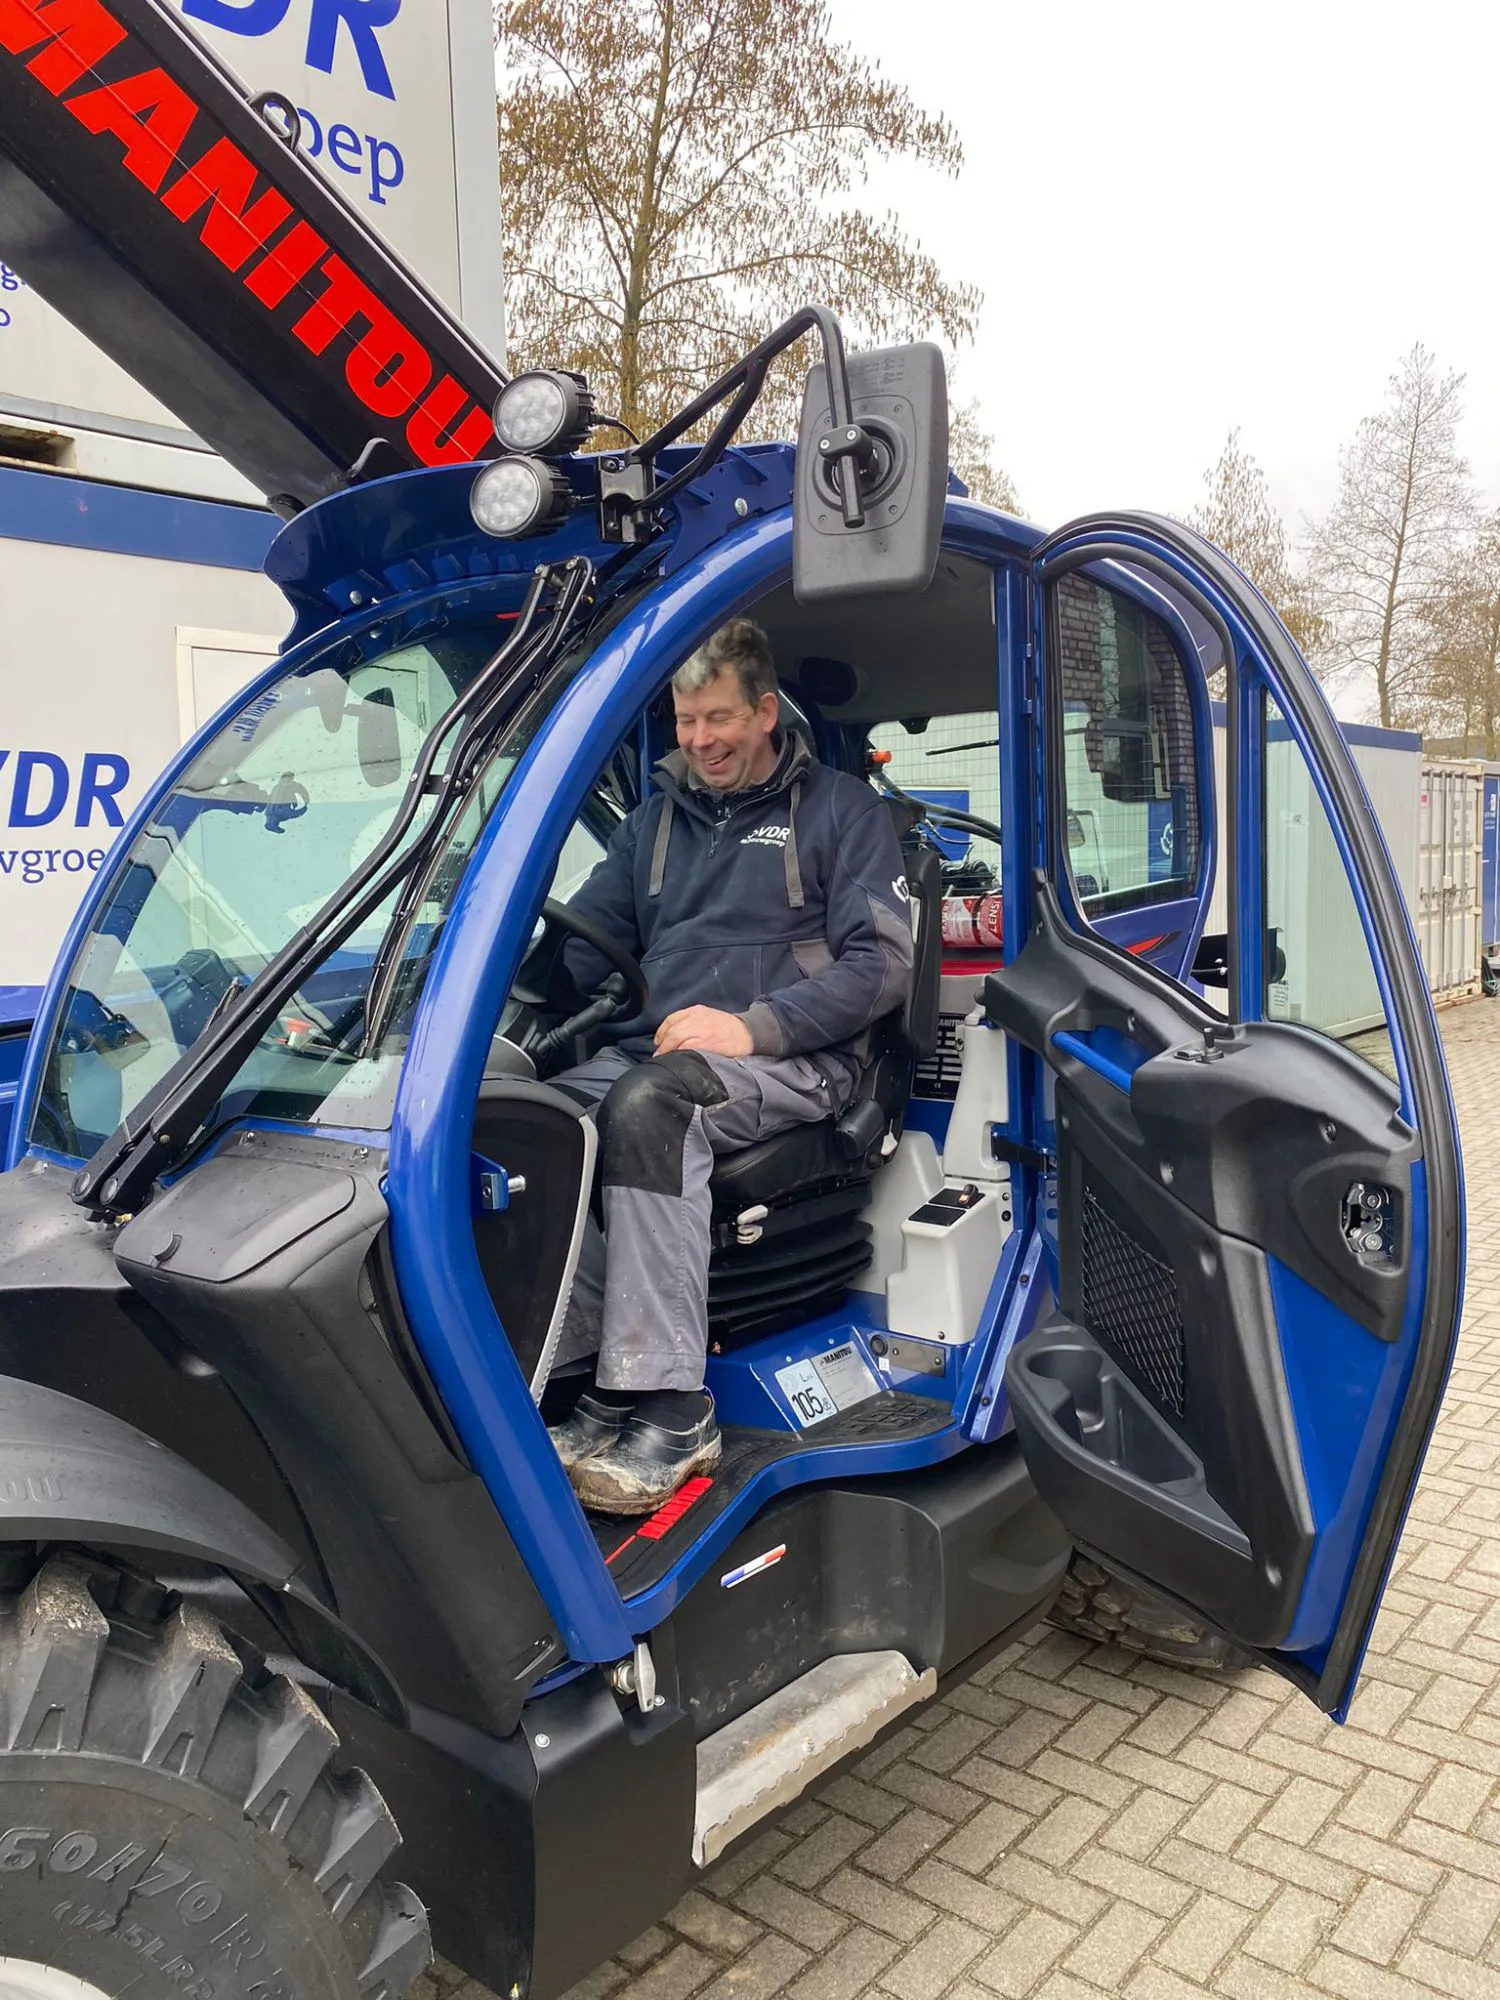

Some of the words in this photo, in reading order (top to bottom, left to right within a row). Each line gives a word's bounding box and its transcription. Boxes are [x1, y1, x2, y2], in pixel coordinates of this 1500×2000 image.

[0, 0, 494, 468] MANITOU
[0, 750, 130, 827] DR
[757, 825, 791, 841] VDR
[791, 1387, 824, 1421] 105
